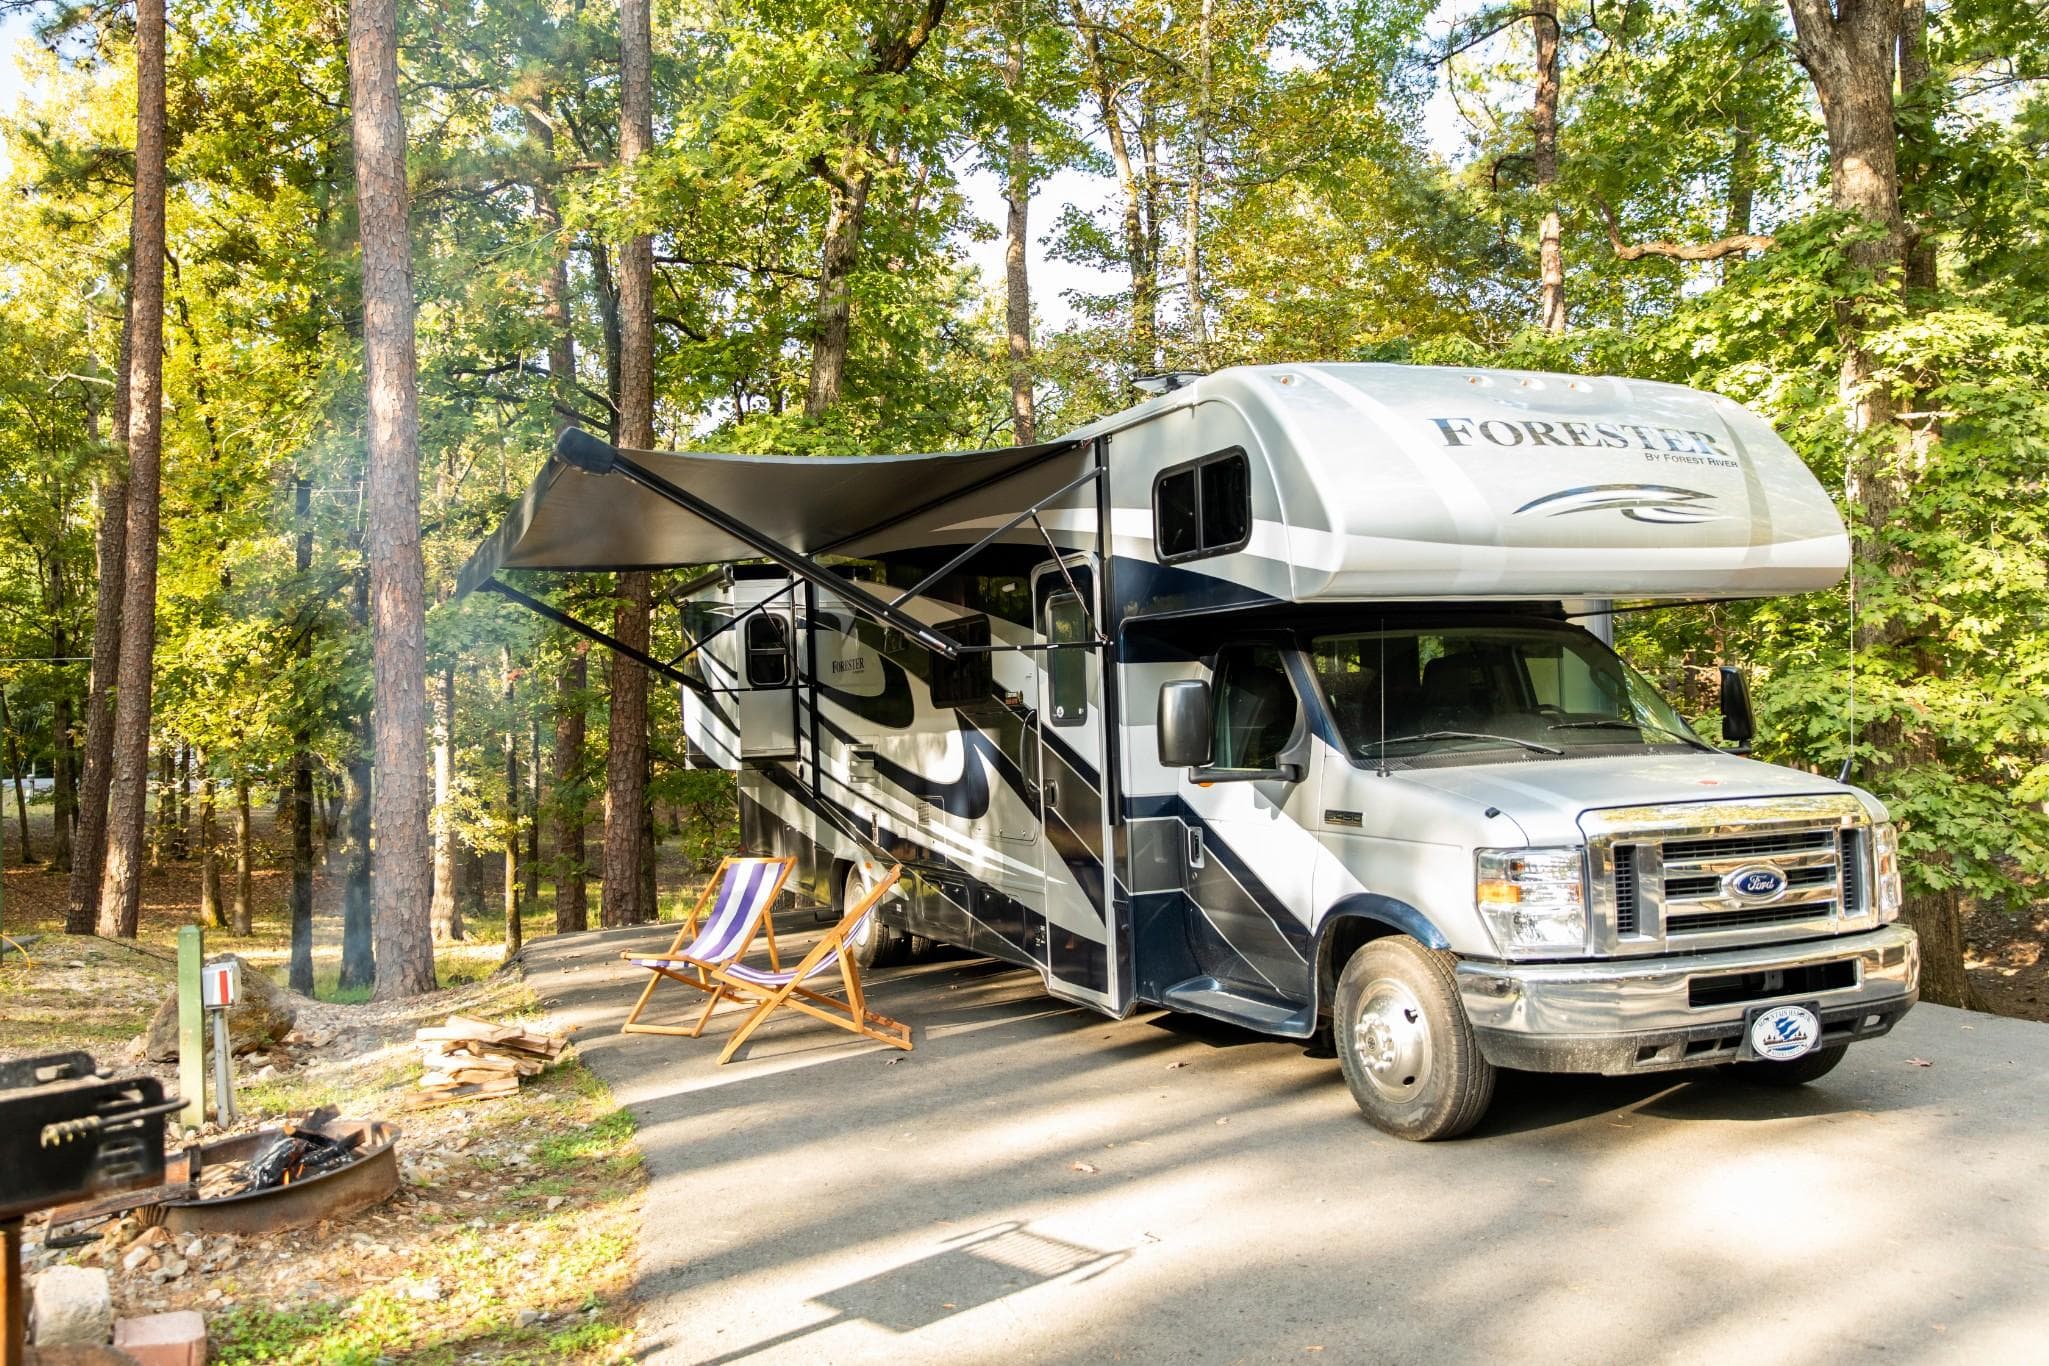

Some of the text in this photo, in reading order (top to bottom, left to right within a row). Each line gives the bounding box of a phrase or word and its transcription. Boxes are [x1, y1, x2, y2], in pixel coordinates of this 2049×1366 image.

[1428, 417, 1730, 457] FORESTER
[1644, 453, 1738, 468] BY FOREST RIVER
[831, 657, 865, 673] FORESTER
[1747, 873, 1776, 891] Ford
